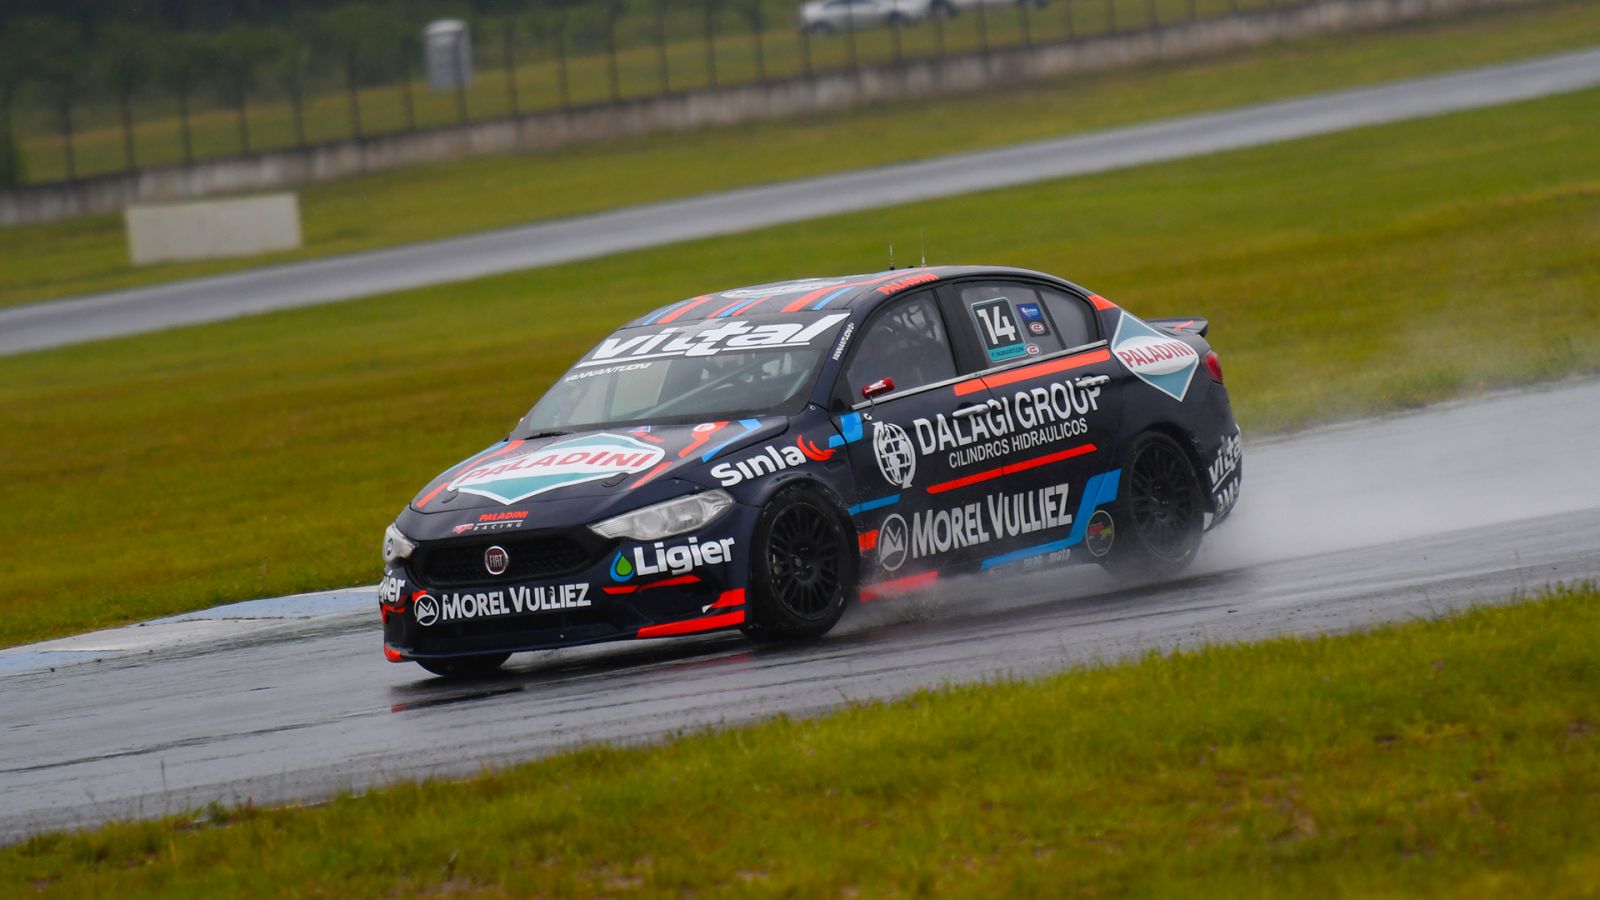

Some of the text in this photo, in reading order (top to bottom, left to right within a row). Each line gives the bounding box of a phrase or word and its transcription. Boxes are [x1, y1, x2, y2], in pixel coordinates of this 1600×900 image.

[976, 306, 1016, 345] 14
[1117, 341, 1195, 369] PALADINI
[913, 378, 1101, 456] DALAGI GROUP
[949, 418, 1088, 469] CILINDROS HIDRAULICOS
[458, 451, 656, 485] PALADINI
[473, 522, 522, 531] RACING
[478, 510, 529, 522] PALADINI
[912, 482, 1073, 558] MOREL VULLIEZ
[489, 553, 504, 569] FIAT
[633, 536, 735, 576] Ligier
[442, 582, 592, 621] MOREL VULLIEZ
